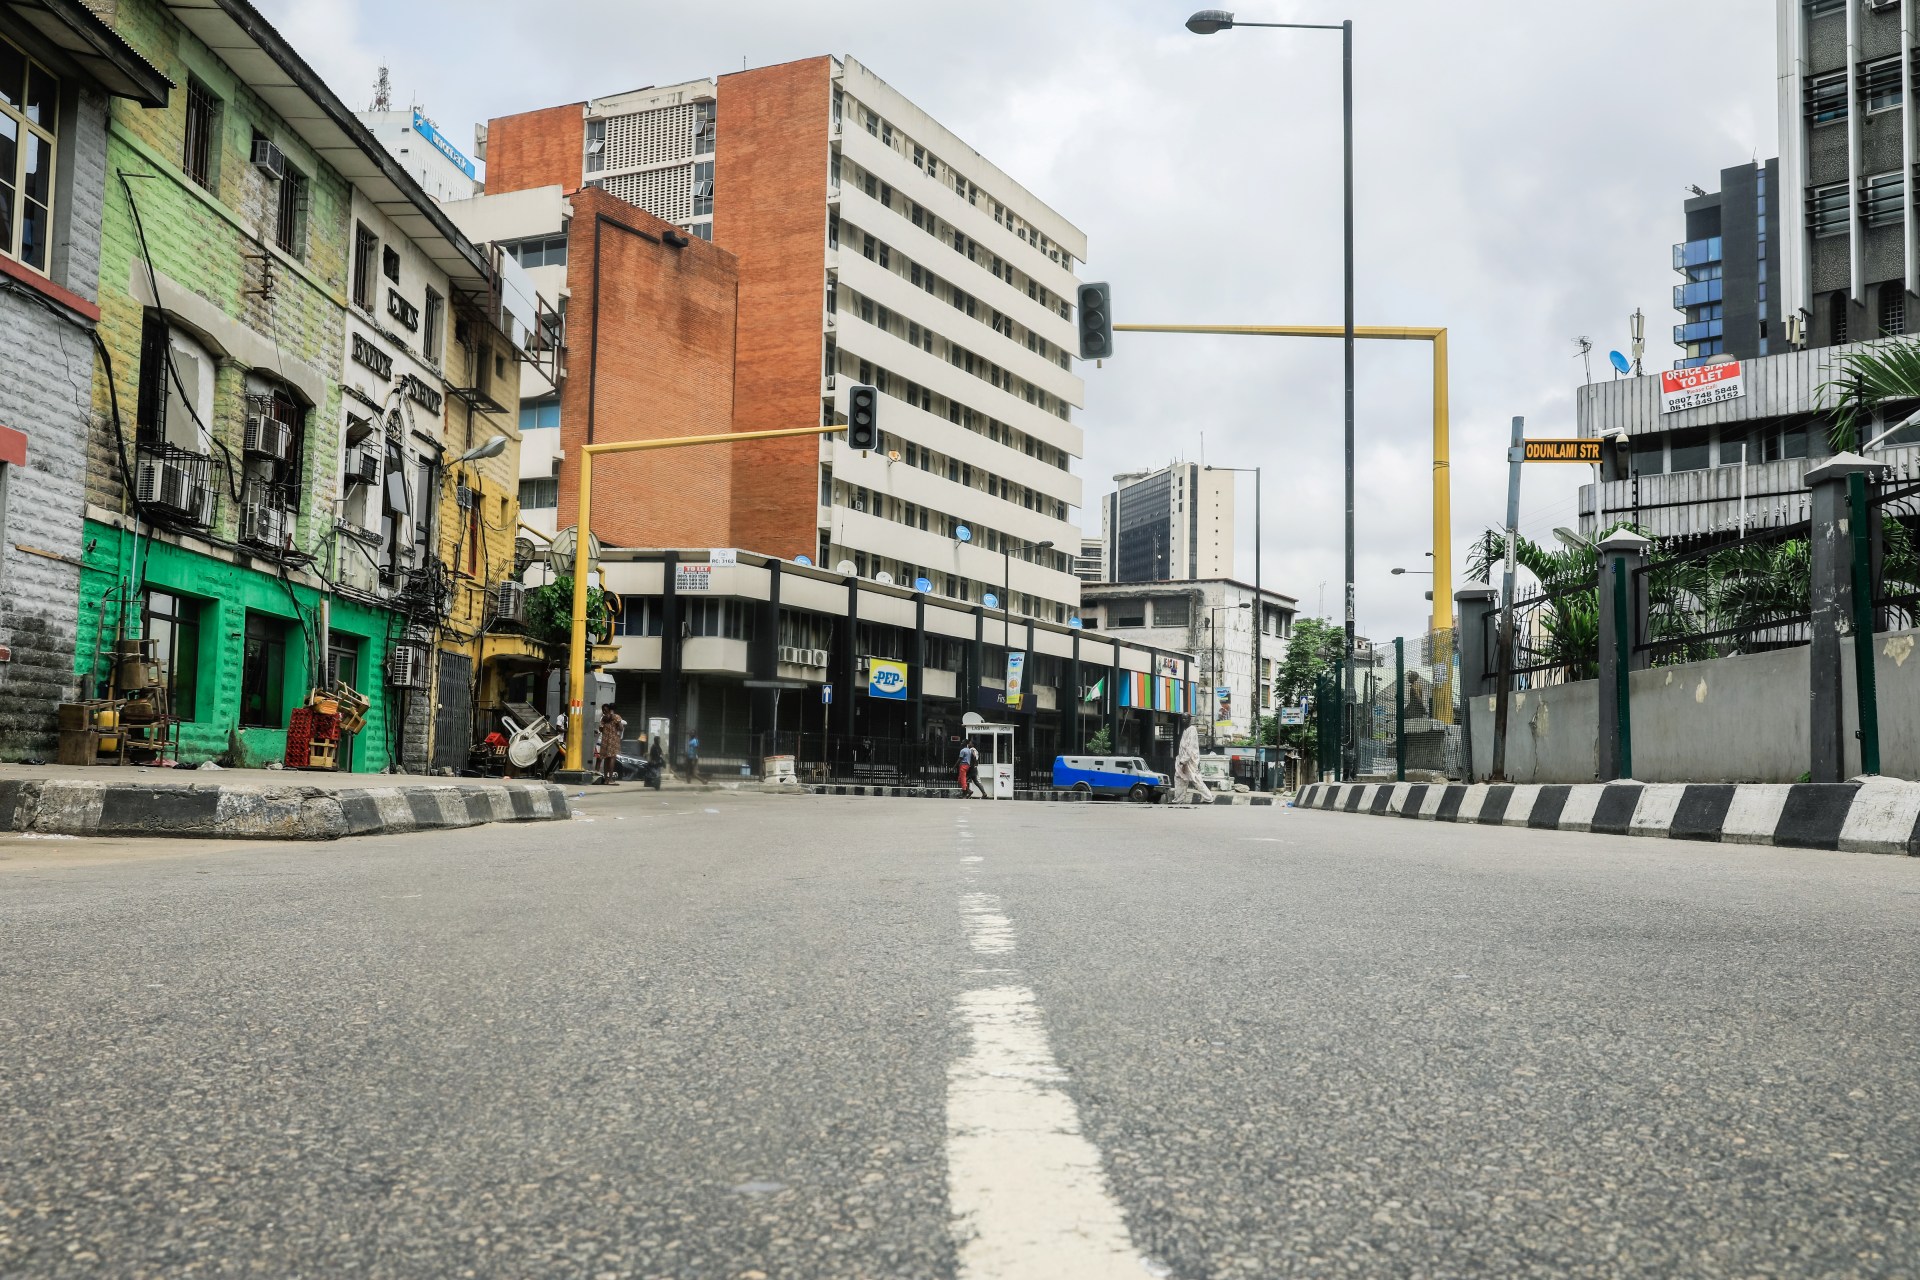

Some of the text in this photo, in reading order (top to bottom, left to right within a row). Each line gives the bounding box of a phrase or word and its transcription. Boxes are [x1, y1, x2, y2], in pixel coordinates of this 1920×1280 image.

[351, 331, 393, 382] BOOK
[1666, 368, 1702, 380] OFFICE
[1680, 369, 1723, 388] TO LET
[408, 372, 442, 416] SHOP
[1669, 395, 1692, 405] 0807
[1715, 384, 1738, 394] 5848
[1526, 443, 1600, 458] ODUNLAMI STR
